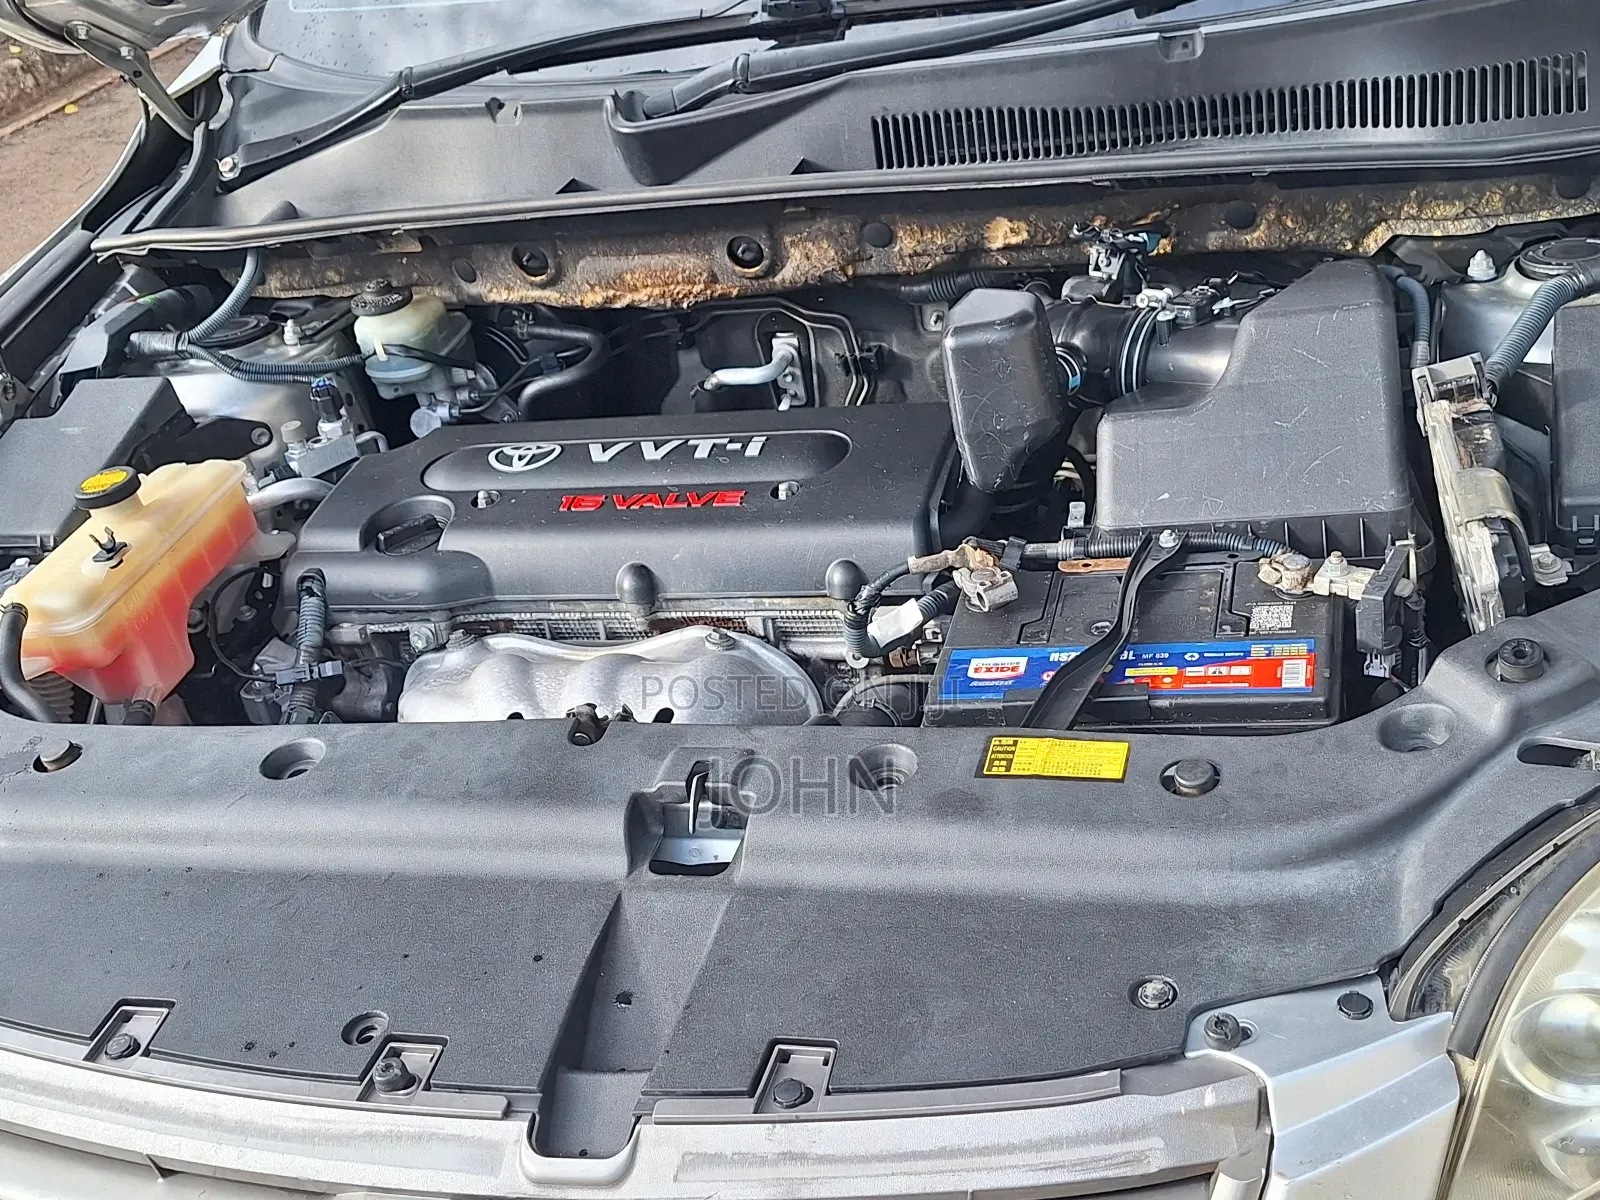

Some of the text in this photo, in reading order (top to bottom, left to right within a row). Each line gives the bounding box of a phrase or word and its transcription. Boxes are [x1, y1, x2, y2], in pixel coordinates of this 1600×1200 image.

[558, 490, 747, 512] 16 VALVE
[973, 666, 1020, 674] EXIDE
